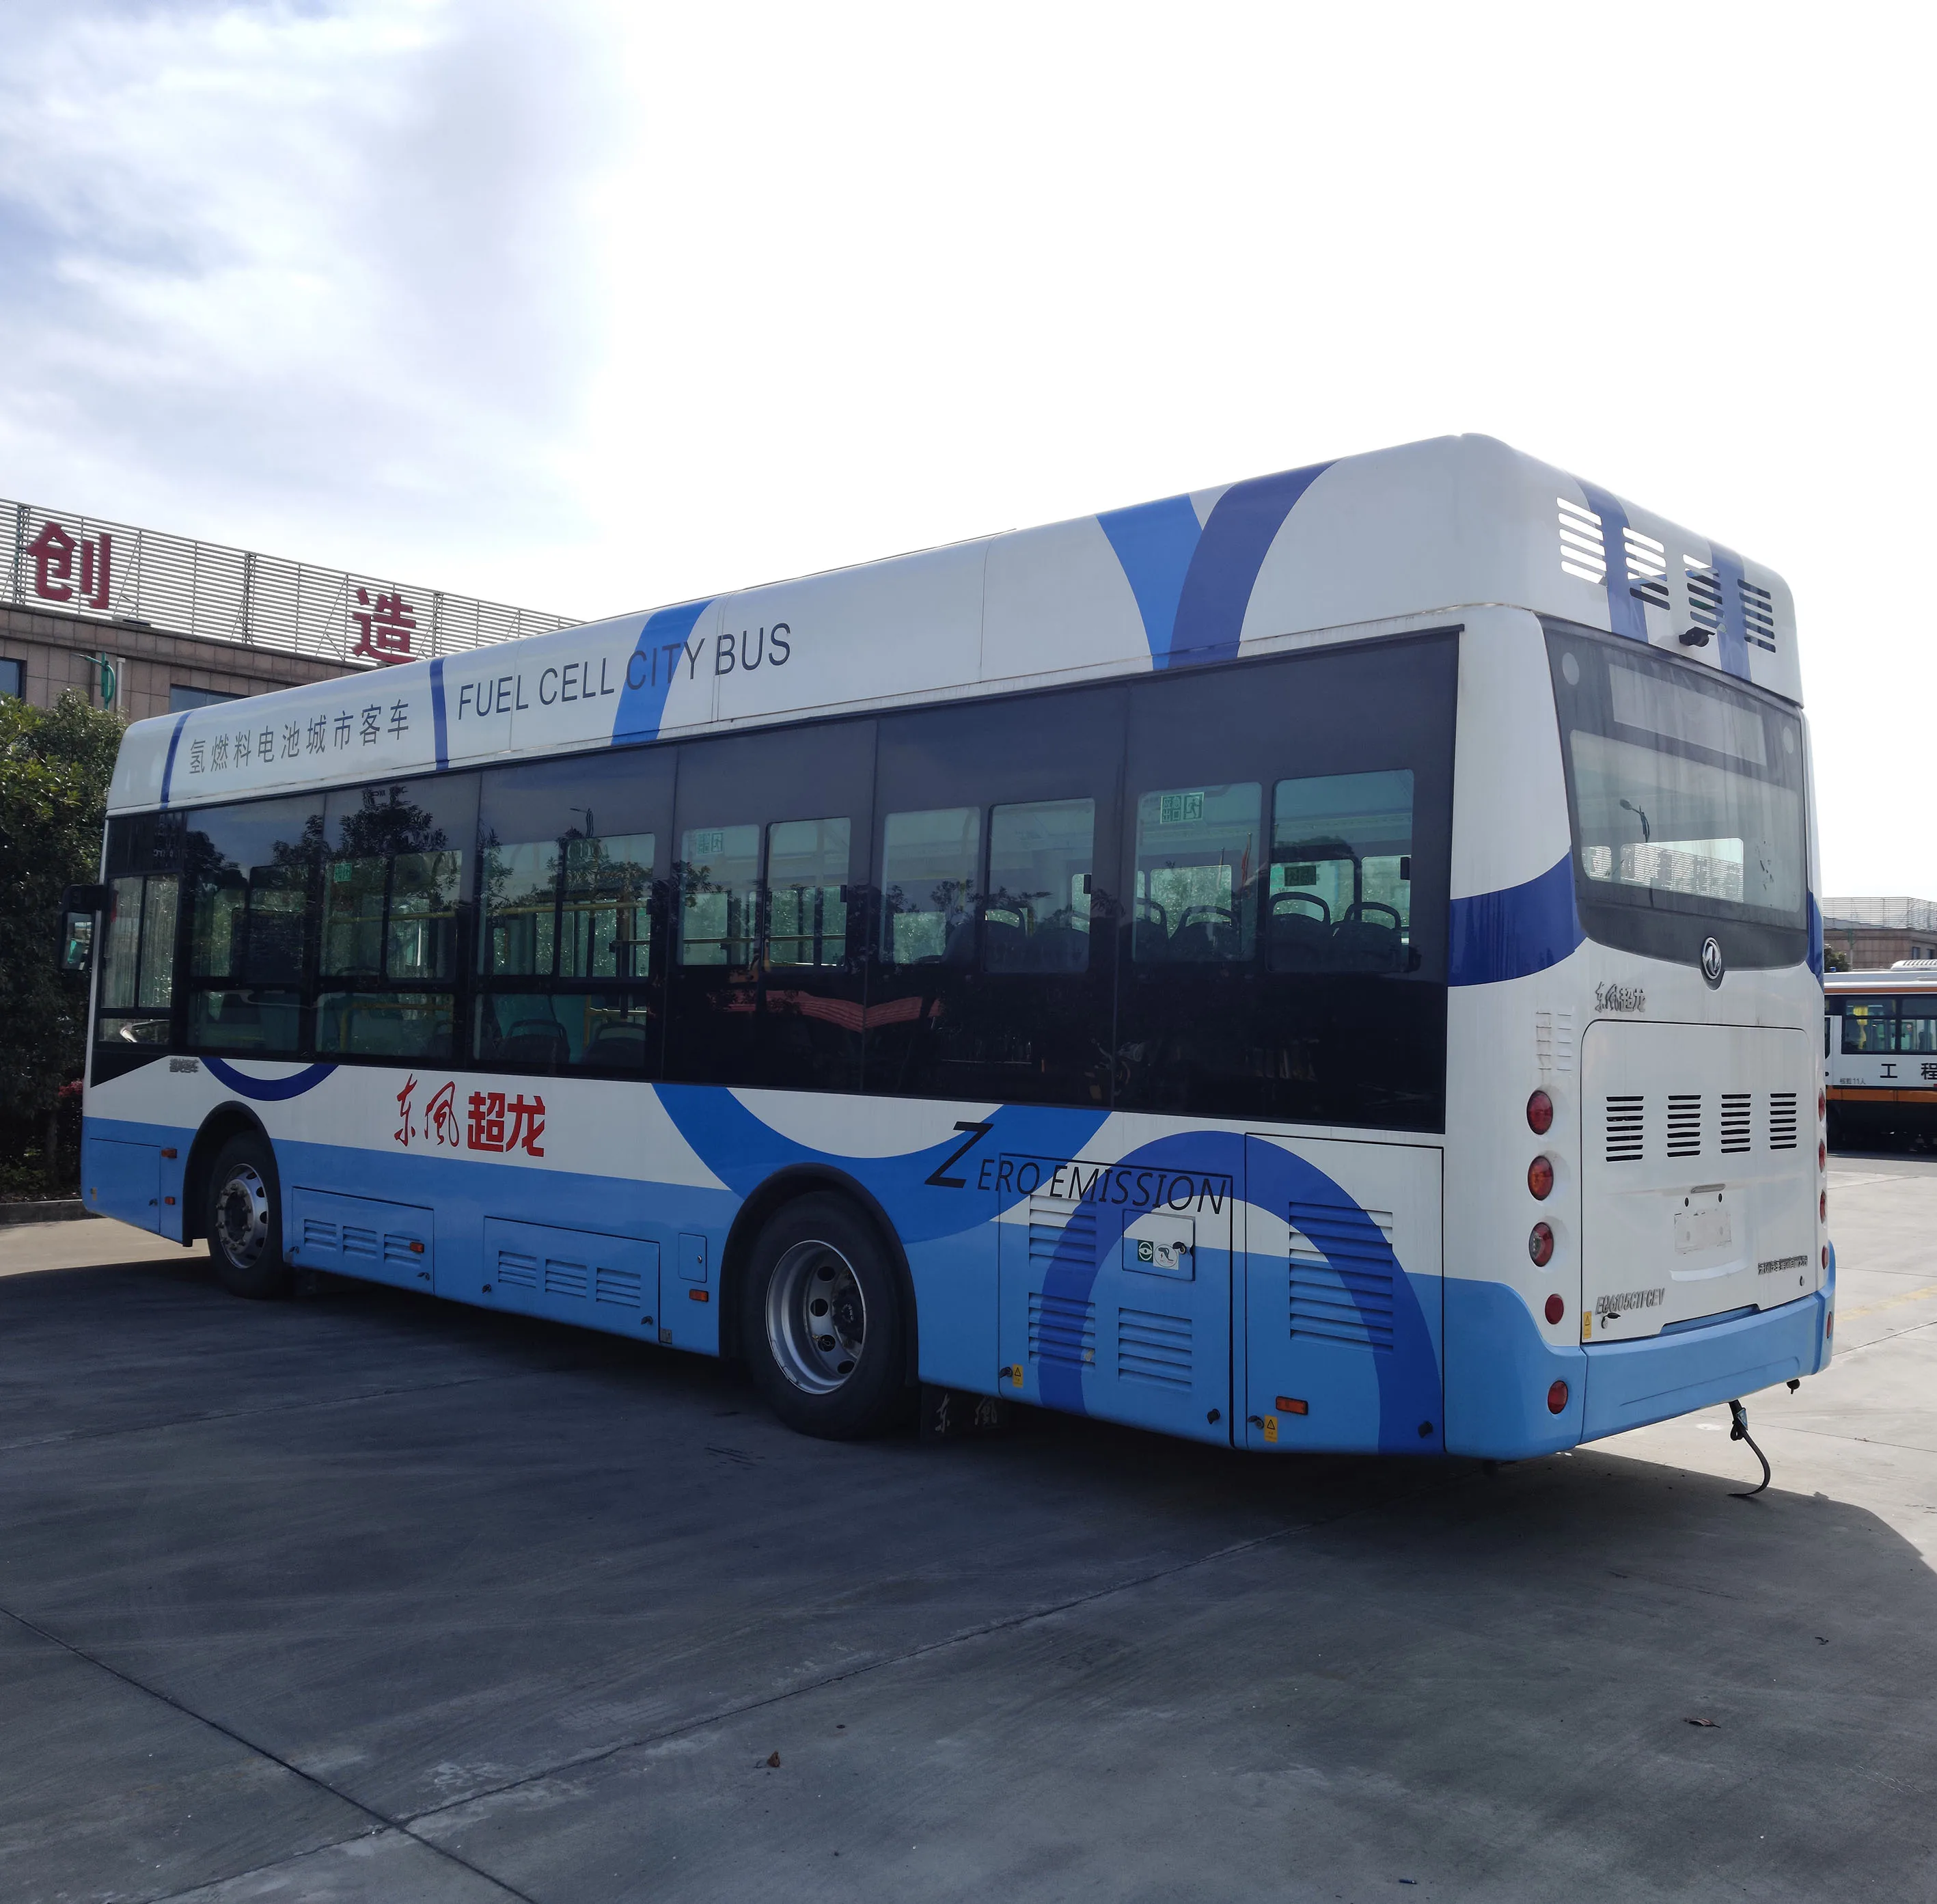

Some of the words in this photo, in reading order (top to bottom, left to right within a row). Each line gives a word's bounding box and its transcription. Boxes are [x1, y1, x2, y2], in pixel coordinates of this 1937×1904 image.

[26, 521, 111, 609] 创
[352, 587, 417, 664] 造
[458, 675, 528, 720] FUEL
[539, 657, 614, 705] CELL
[626, 638, 705, 690] CITY
[715, 623, 791, 676] BUS
[189, 698, 409, 774] 氢燃料电池城市客车
[924, 1121, 1039, 1195] ZERO
[1049, 1165, 1226, 1215] EMISSION
